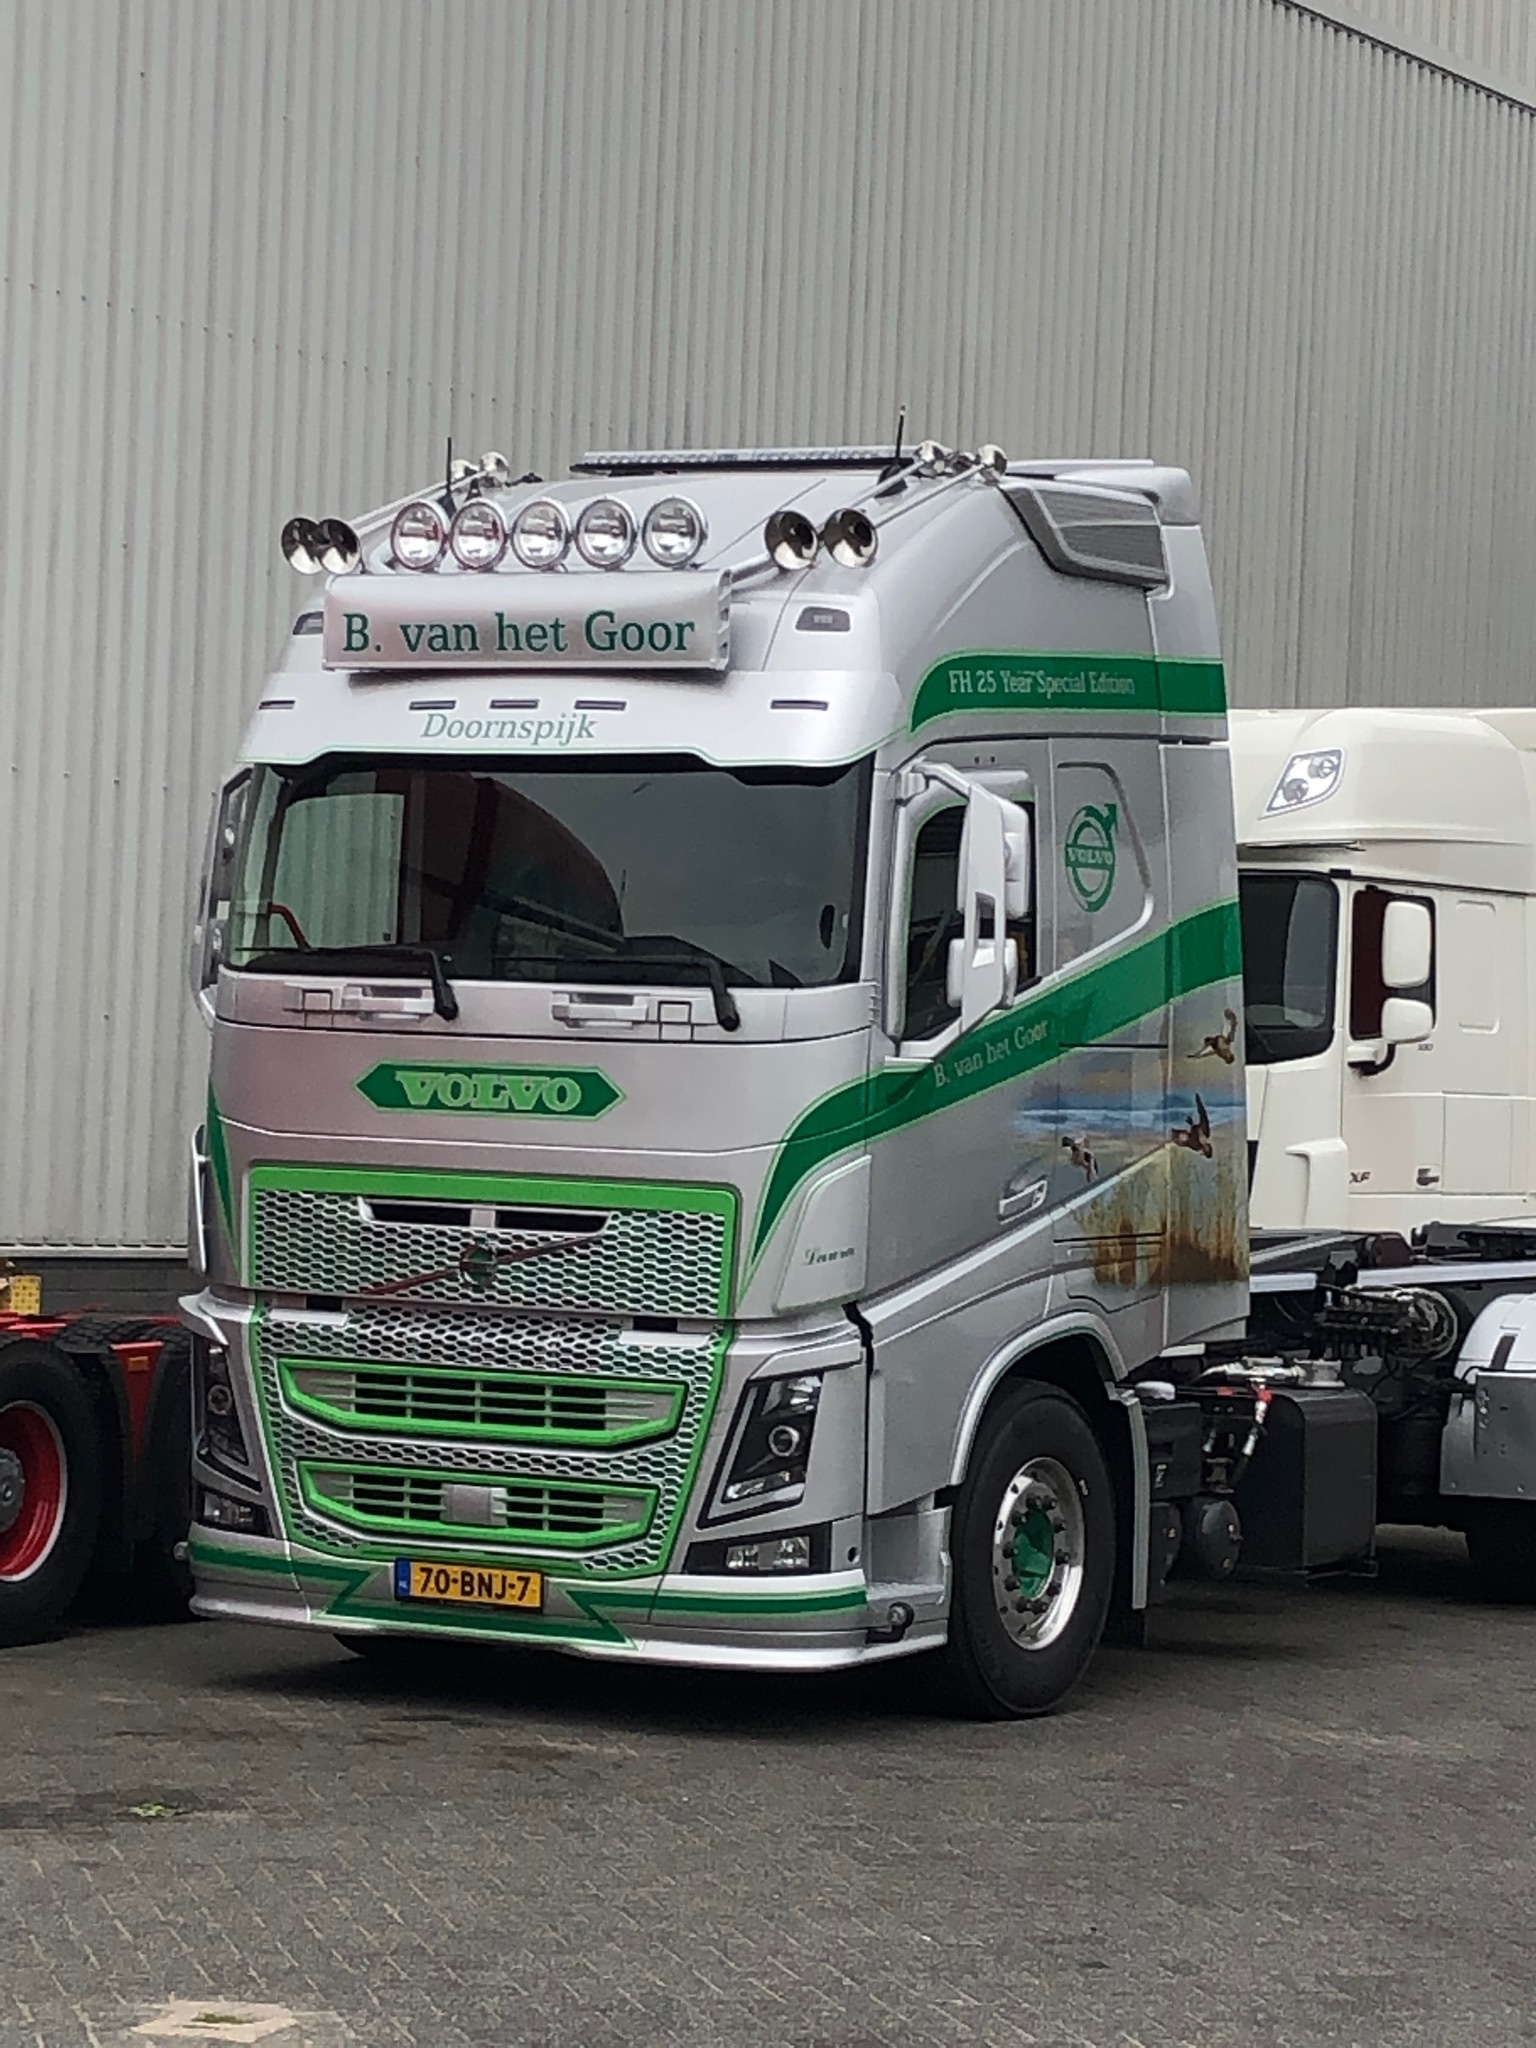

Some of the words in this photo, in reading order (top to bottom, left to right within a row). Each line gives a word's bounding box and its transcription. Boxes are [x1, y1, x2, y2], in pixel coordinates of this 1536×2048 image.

[342, 613, 382, 652] B.
[398, 621, 480, 652] van
[494, 612, 569, 652] het
[584, 610, 695, 653] Goor
[949, 670, 973, 693] FH
[976, 670, 997, 693] 25
[1000, 670, 1033, 693] Year
[1035, 670, 1087, 699] Special
[1089, 671, 1136, 695] Edition
[420, 712, 598, 746] Doornspijk
[1067, 847, 1114, 866] VOLVO
[933, 1063, 951, 1088] B.
[954, 1053, 983, 1077] van
[985, 1038, 1011, 1064] het
[1014, 1020, 1048, 1049] Goor
[395, 1070, 582, 1113] VOLVO
[419, 1566, 531, 1602] 70-BNJ-7
